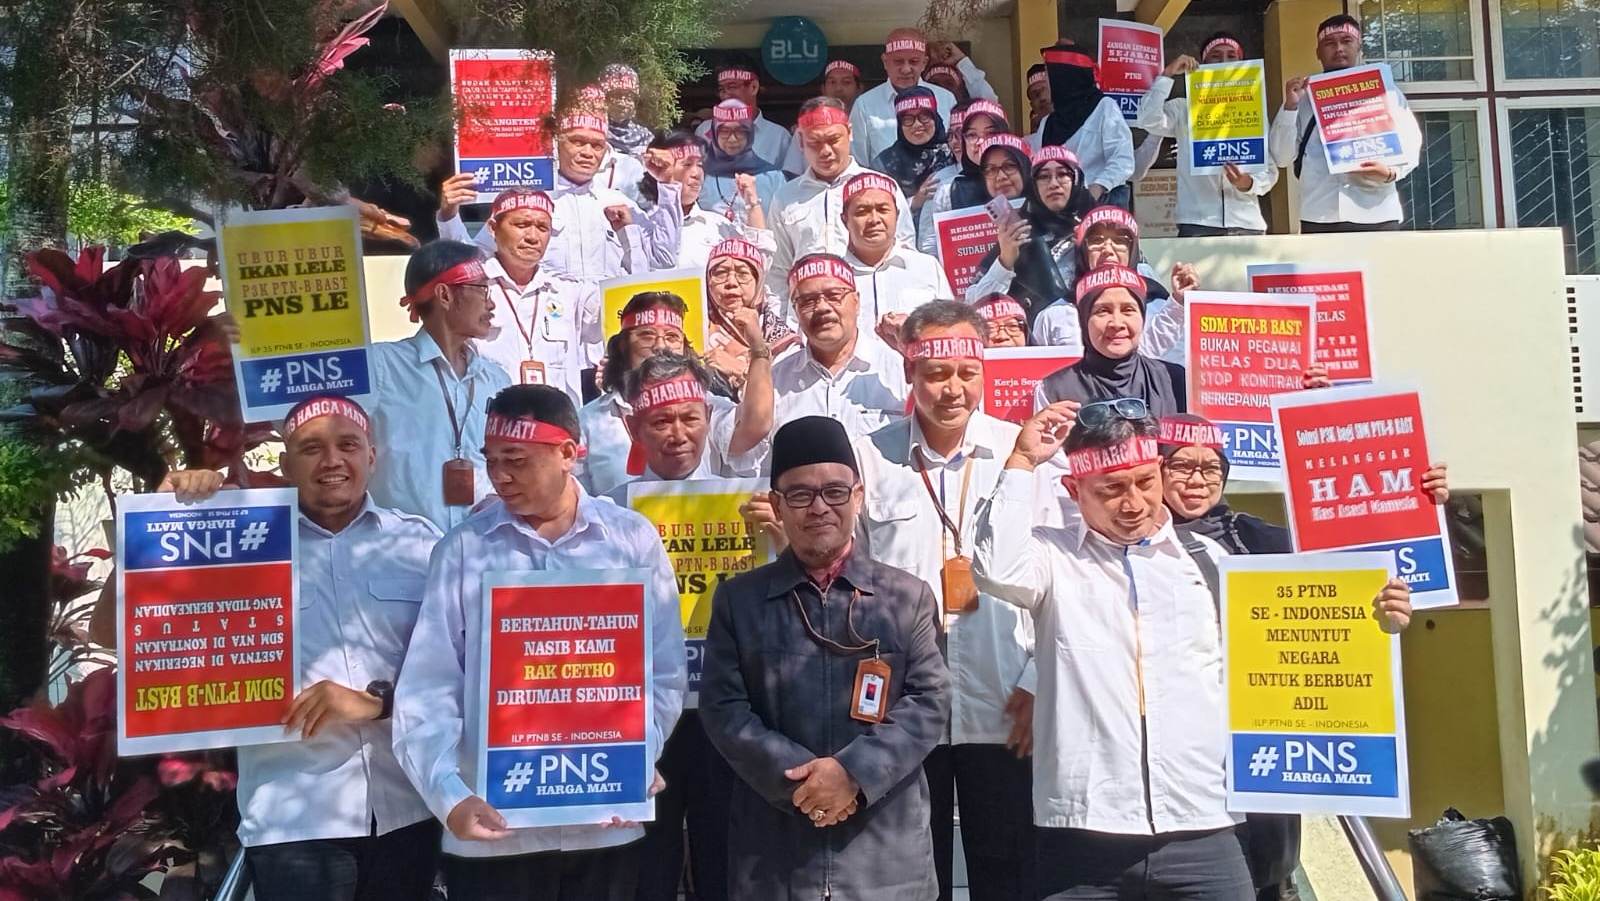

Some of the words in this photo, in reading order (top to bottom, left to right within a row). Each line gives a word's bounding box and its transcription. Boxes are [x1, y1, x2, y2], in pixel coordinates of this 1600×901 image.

[771, 40, 818, 58] BLU
[1316, 88, 1335, 100] SDM
[1004, 135, 1022, 148] MATI
[1203, 142, 1250, 160] #PNS
[522, 178, 542, 186] MATI
[848, 178, 862, 196] PNS
[500, 196, 516, 210] PNS
[1092, 210, 1123, 224] HARGA
[238, 248, 288, 266] UBUR
[296, 246, 344, 262] UBUR
[957, 244, 986, 256] SUDAH
[238, 264, 289, 280] IKAN
[295, 260, 346, 276] LELE
[798, 260, 832, 280] HARGA
[1086, 268, 1118, 288] HARGA
[242, 284, 268, 298] P3K
[272, 278, 312, 296] PTN-B
[316, 276, 348, 292] BAST
[244, 296, 304, 318] PNS
[312, 291, 348, 311] LE
[635, 310, 656, 326] PNS
[1317, 310, 1346, 322] ELAS
[1200, 316, 1229, 334] SDM
[1230, 318, 1268, 334] PTN-B
[1270, 318, 1302, 336] BAST
[310, 338, 352, 350] INDONESIA
[933, 339, 974, 357] HARGA
[1200, 339, 1240, 352] BUKAN
[1248, 340, 1302, 354] PEGAWAI
[1200, 355, 1251, 368] KELAS
[1264, 356, 1302, 370] DUA
[260, 356, 342, 393] #PNS
[1200, 372, 1232, 386] STOP
[1240, 374, 1304, 390] KONTRAK
[286, 382, 324, 394] HARGA
[326, 379, 354, 390] MATI
[994, 378, 1019, 388] Kerja
[650, 380, 692, 405] HARGA
[1200, 393, 1272, 408] BERKEPANJA
[296, 400, 340, 426] HARGA
[343, 404, 367, 431] MATI
[500, 418, 536, 440] MATI
[1073, 455, 1091, 475] PNS
[1094, 438, 1140, 469] HARGA
[1305, 448, 1411, 470] MELANGGAR
[1308, 468, 1415, 502] HAM
[147, 521, 184, 532] MATI
[186, 519, 236, 530] HARGA
[658, 523, 694, 537] BUR
[704, 522, 755, 536] UBUR
[160, 522, 270, 562] #PNS
[701, 536, 756, 552] LELE
[676, 556, 717, 572] PTN-B
[722, 555, 756, 570] BAST
[1276, 586, 1292, 598] 35
[1298, 584, 1337, 598] PTNB
[135, 601, 216, 618] BERKEADILAN
[218, 598, 250, 613] TIDAK
[252, 597, 282, 610] YANG
[1251, 606, 1270, 620] SE
[1283, 606, 1366, 620] INDONESIA
[500, 614, 638, 633] BERTAHUN-TAHUN
[214, 636, 226, 648] DI
[232, 634, 255, 646] NYA
[261, 632, 284, 644] SDM
[1267, 628, 1350, 642] MENUNTUT
[136, 638, 207, 654] KONTRAKAN
[524, 640, 570, 656] NASIB
[574, 638, 616, 655] KAMI
[136, 656, 205, 672] NEGERIKAN
[212, 654, 224, 666] DI
[230, 650, 284, 664] ASETNYA
[1280, 651, 1340, 664] NEGARA
[524, 664, 558, 681] RAK
[560, 662, 616, 680] CETHO
[1248, 673, 1300, 686] UNTUK
[1304, 673, 1374, 688] BERBUAT
[188, 680, 240, 708] PTN-B
[245, 677, 284, 702] SDM
[496, 688, 572, 706] DIRUMAH
[576, 686, 642, 702] SENDIRI
[136, 684, 182, 712] BAST
[1294, 696, 1328, 710] ADIL
[1270, 720, 1292, 728] PTNB
[1295, 720, 1306, 728] SE
[1315, 720, 1368, 729] INDONESIA
[512, 734, 524, 743] ILP
[526, 734, 550, 742] PTNB
[552, 733, 562, 742] SE
[571, 731, 622, 740] INDONESIA
[1249, 740, 1358, 776] #PNS
[504, 752, 609, 792] #PNS
[1282, 772, 1332, 784] HARGA
[1334, 772, 1372, 784] MATI
[536, 784, 585, 796] HARGA
[587, 782, 622, 794] MATI
